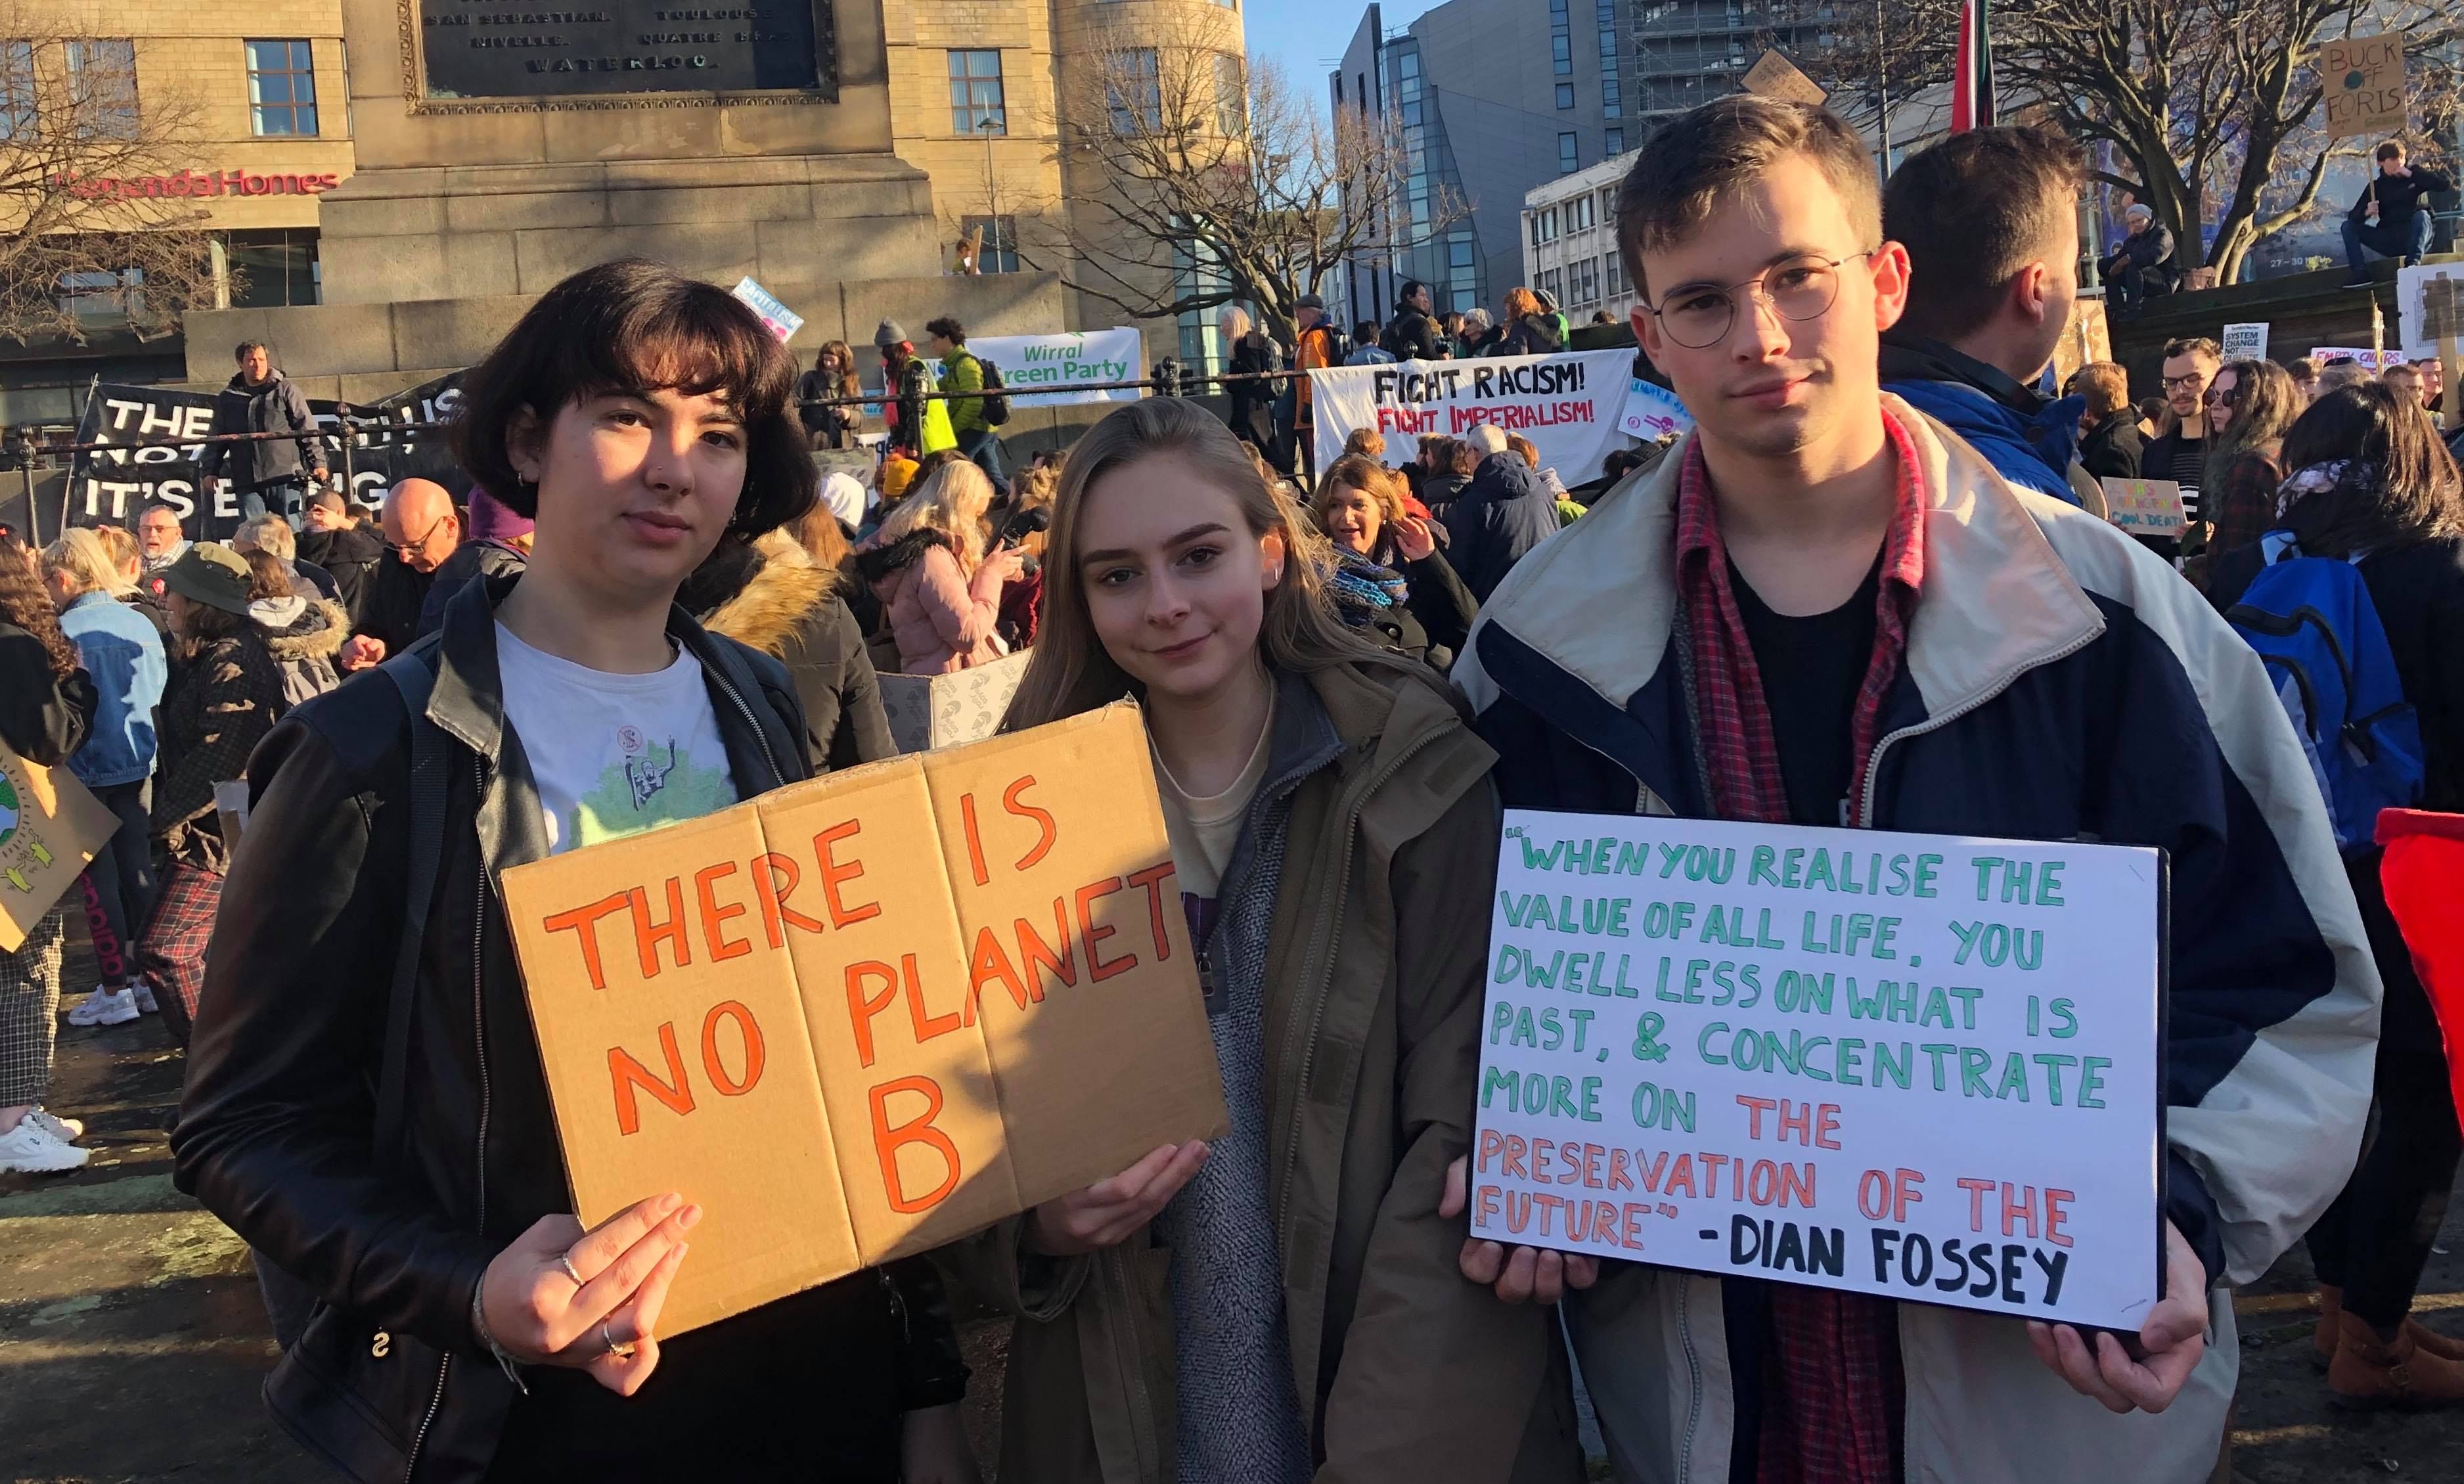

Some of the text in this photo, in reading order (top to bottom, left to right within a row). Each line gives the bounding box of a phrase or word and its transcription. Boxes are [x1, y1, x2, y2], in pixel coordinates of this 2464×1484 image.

[2329, 42, 2398, 72] BUCK
[2326, 87, 2401, 122] FORIS
[221, 168, 340, 196] Homes
[740, 278, 801, 330] CAPITALISM
[1023, 342, 1083, 362] Wirral
[2225, 339, 2260, 348] CHANGE
[2226, 332, 2258, 340] SYSTEM
[997, 357, 1127, 384] reen Party
[1374, 362, 1585, 405] FIGHT RACISM!
[106, 398, 213, 439] THE
[1377, 408, 1439, 436] FIGHT
[85, 478, 194, 521] IT'S
[543, 775, 1057, 990] THERE IS
[1658, 842, 1736, 885] YOU
[1747, 845, 1944, 899] REALISE
[1971, 857, 2066, 907] THE
[1499, 890, 1632, 937] VALUE
[1642, 901, 1696, 940] OF
[1699, 904, 1785, 951] ALL
[1948, 920, 2044, 971] YOU
[606, 860, 1175, 1136] NO PLANET
[1493, 944, 2078, 1039] DWELL LESS ON WHAT IS
[1489, 1001, 2113, 1109] PAST, & CONCENTRATE
[1481, 1066, 1842, 1151] MORE ON THE
[868, 1075, 962, 1214] B
[1477, 1129, 2076, 1248] PRESERVATION OF THE
[1871, 1227, 2069, 1307] FOSSEY
